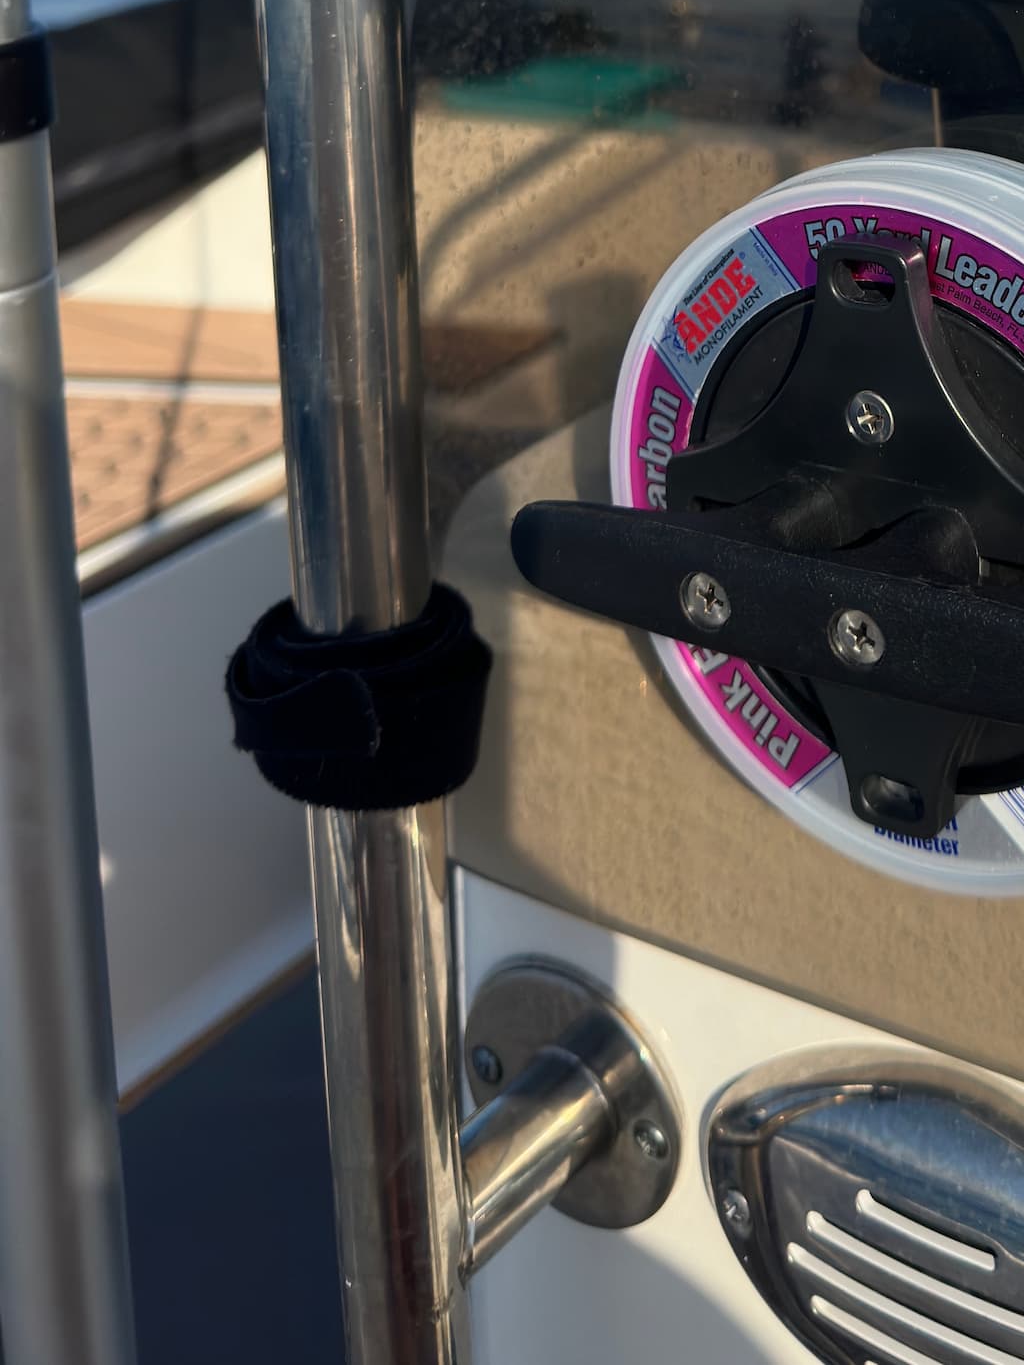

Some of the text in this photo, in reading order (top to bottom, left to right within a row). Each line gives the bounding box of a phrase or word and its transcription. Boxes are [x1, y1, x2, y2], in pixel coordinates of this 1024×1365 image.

[804, 217, 846, 260] 50
[674, 256, 757, 355] ANDE
[694, 285, 764, 365] MONOFILAMENT
[947, 286, 971, 305] Palm
[973, 299, 1004, 328] Beach,
[1007, 322, 1020, 339] FL
[719, 668, 801, 771] Pink
